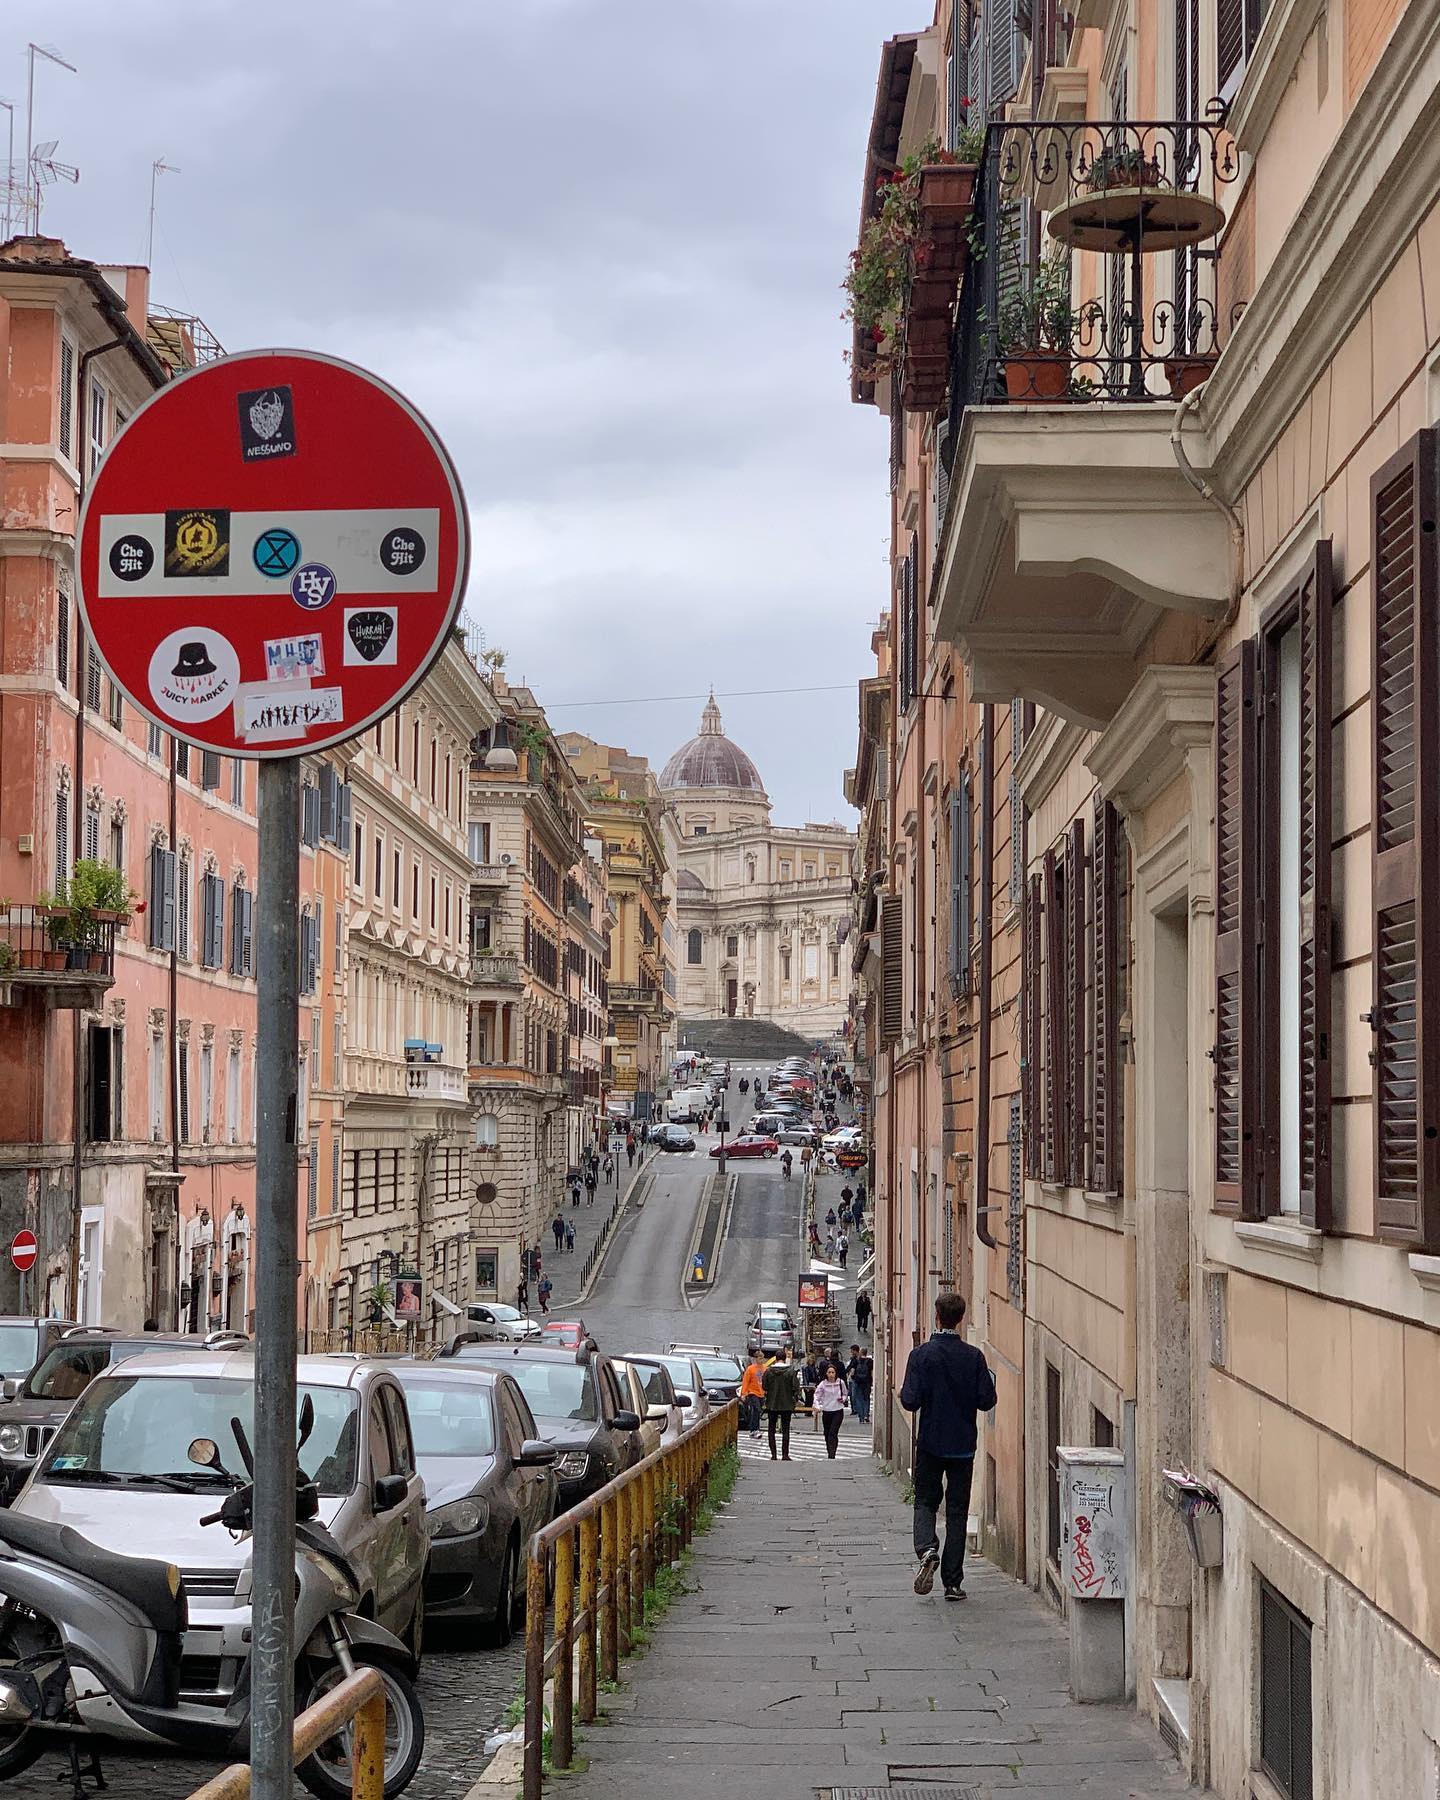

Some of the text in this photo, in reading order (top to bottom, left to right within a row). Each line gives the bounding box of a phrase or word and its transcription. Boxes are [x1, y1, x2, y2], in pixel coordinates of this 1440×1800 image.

[247, 442, 292, 456] NESSUNO
[391, 536, 415, 550] Che
[121, 544, 143, 557] Che
[161, 679, 229, 704] JUICY MARKET
